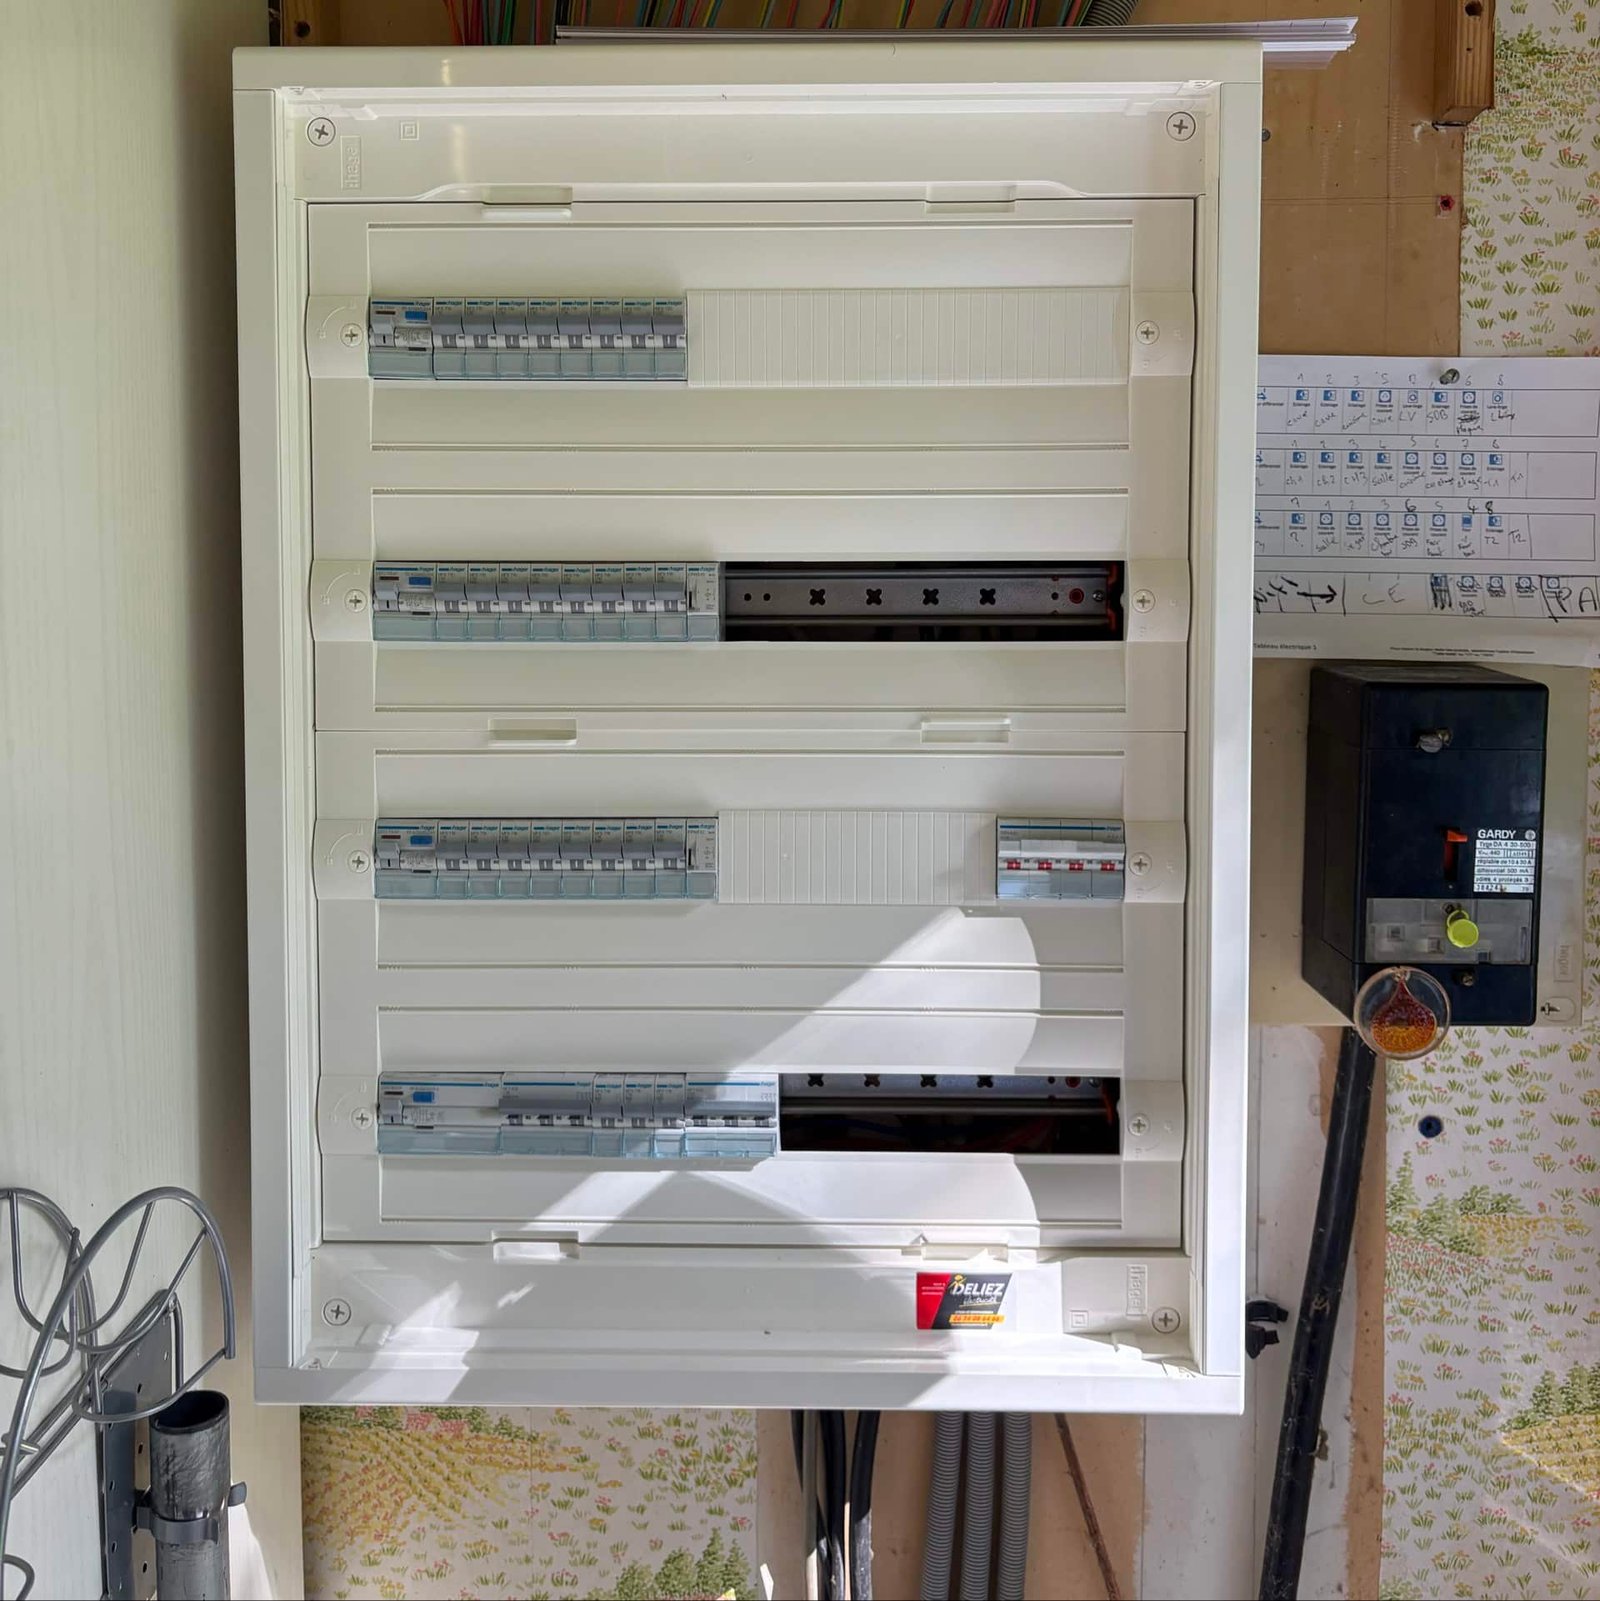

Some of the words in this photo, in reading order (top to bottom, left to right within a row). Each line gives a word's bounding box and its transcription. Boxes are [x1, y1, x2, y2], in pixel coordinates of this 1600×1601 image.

[1485, 500, 1493, 515] 8
[1477, 829, 1516, 839] GARDY
[951, 1281, 1005, 1296] DELIEZ
